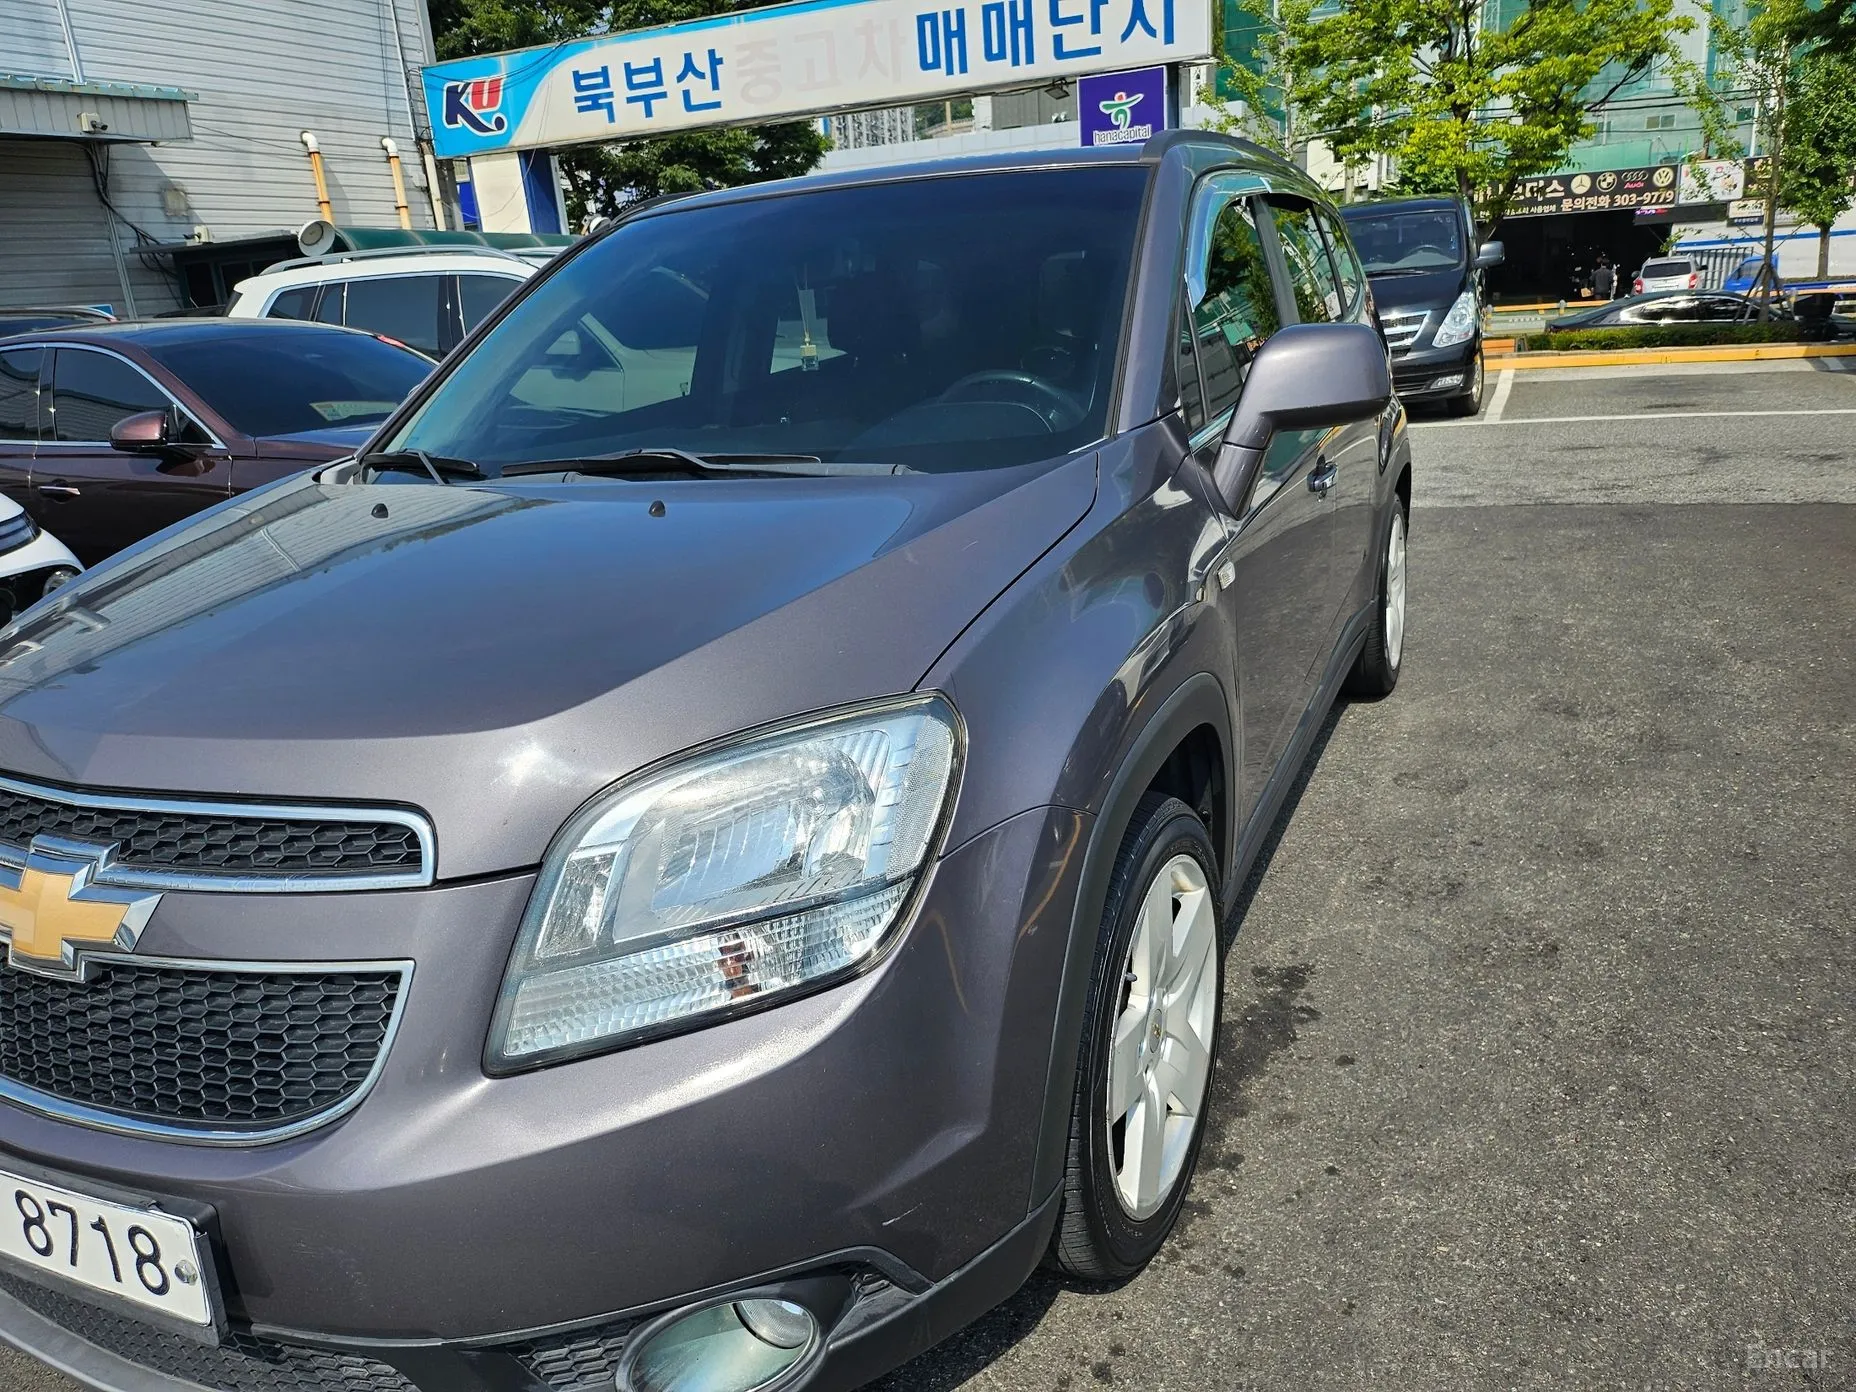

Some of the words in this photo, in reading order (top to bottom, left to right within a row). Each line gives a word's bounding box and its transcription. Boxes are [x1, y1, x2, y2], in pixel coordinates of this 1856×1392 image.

[572, 48, 724, 123] 북부산
[735, 16, 906, 103] 중고차
[916, 0, 1176, 76] 매매단지
[445, 76, 506, 135] KU
[1093, 125, 1151, 145] hanacapital
[1561, 196, 1610, 212] 문의전화
[1613, 190, 1674, 206] 303-9779
[15, 1189, 170, 1296] 8718
